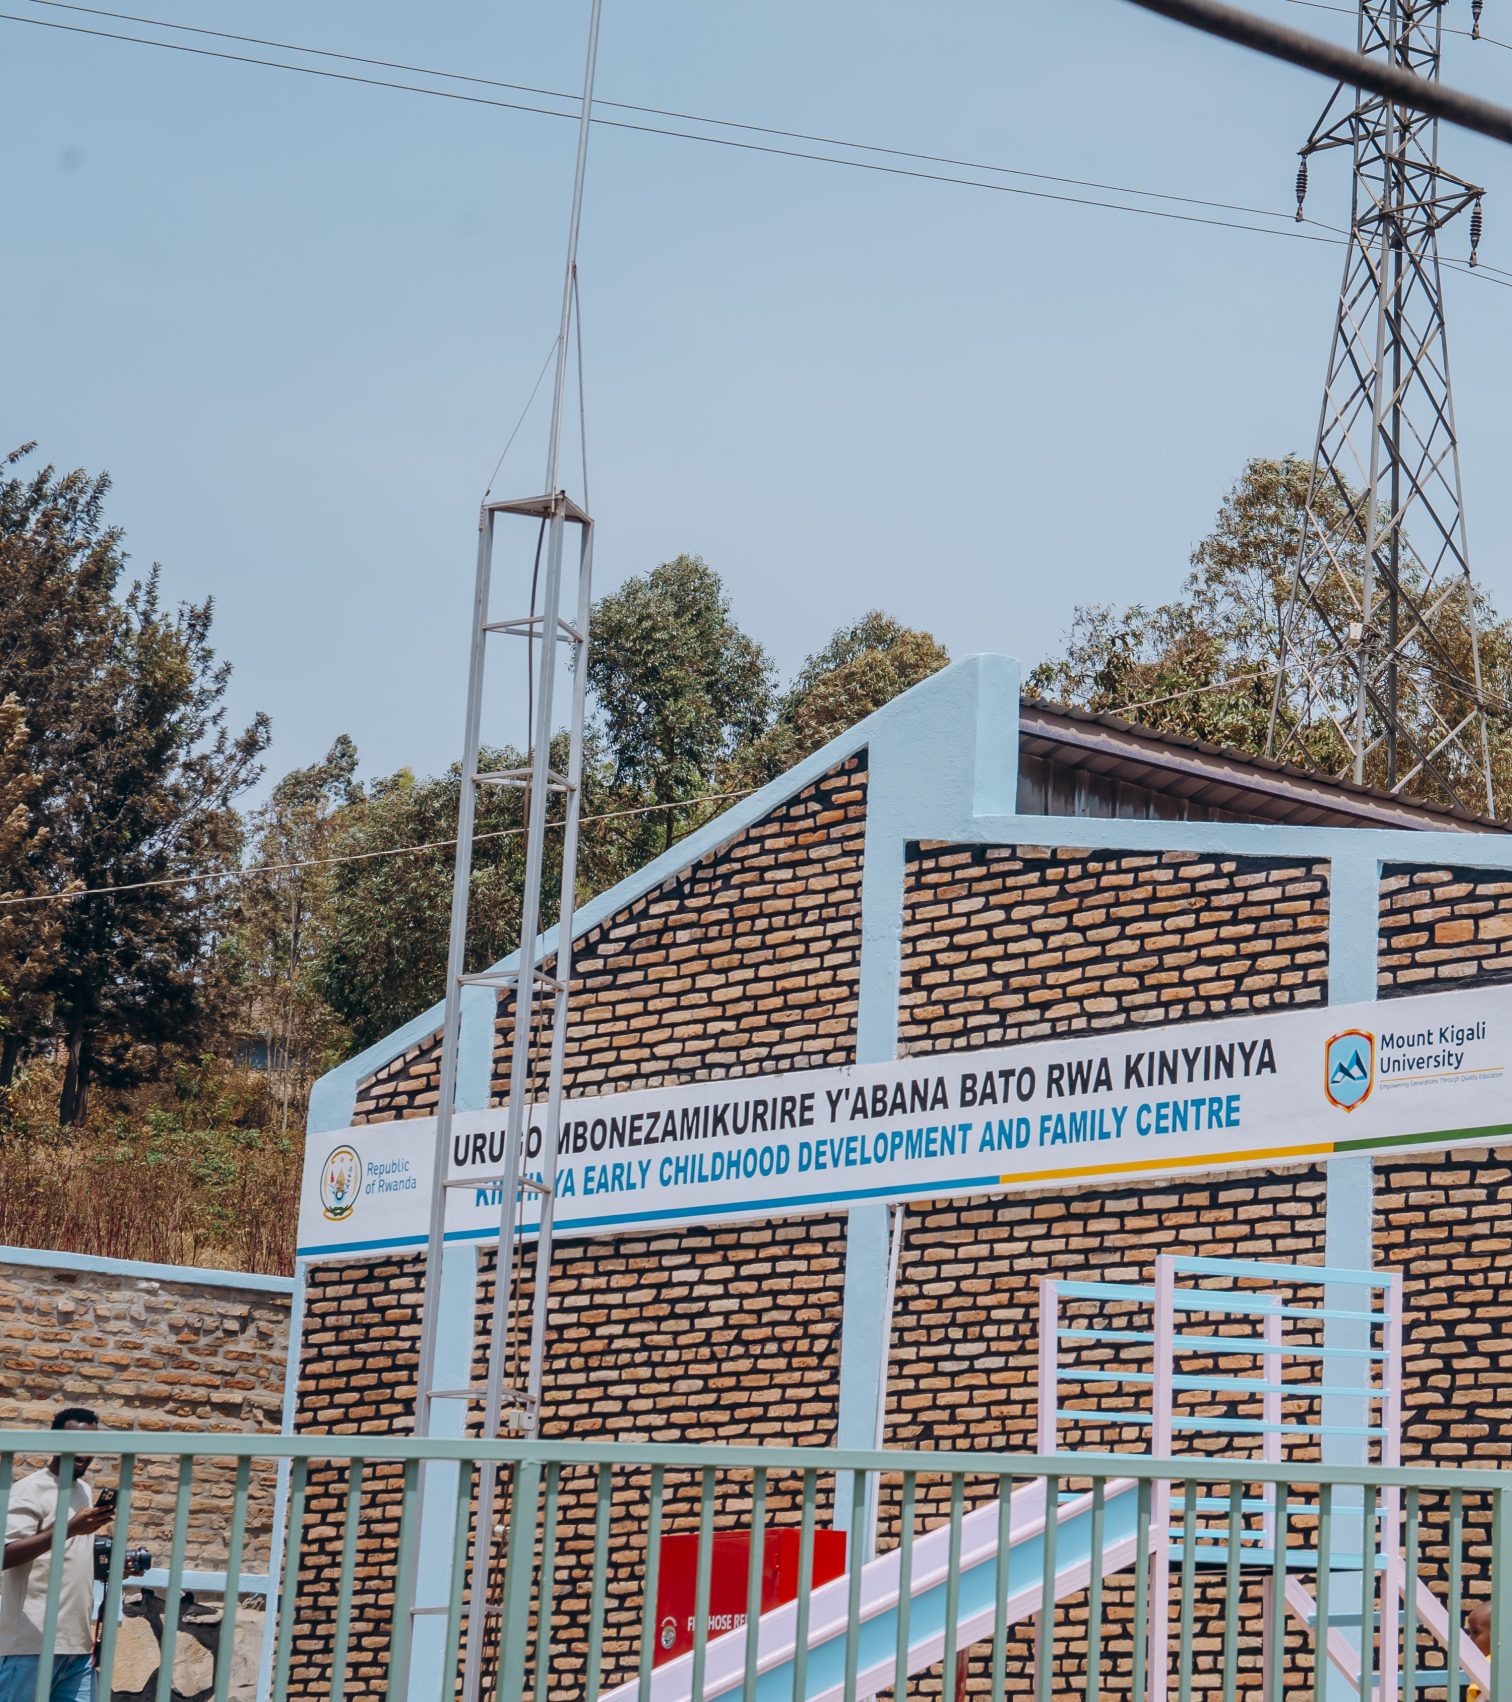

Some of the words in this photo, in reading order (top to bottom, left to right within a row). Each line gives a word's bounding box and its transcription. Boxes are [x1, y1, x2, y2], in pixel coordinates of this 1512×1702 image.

[1380, 1030, 1434, 1050] Mount
[1439, 1021, 1486, 1046] Kigali
[1380, 1049, 1464, 1074] University
[453, 1125, 542, 1167] URUO
[557, 1092, 815, 1155] MBONEZAMIKURIRE
[826, 1076, 948, 1123] Y'ABANA
[960, 1066, 1036, 1108] BATO
[1046, 1056, 1113, 1098] RWA
[1124, 1038, 1277, 1089] KINYINYA
[582, 1158, 652, 1196] EARLY
[659, 1144, 791, 1187] CHILDHOOD
[798, 1122, 972, 1173] DEVELOPMENT
[979, 1116, 1031, 1153] AND
[1039, 1106, 1128, 1145] FAMILY
[1136, 1094, 1241, 1136] CENTRE
[367, 1159, 410, 1177] Republic
[365, 1179, 376, 1195] of
[378, 1176, 417, 1192] Rwanda
[708, 1614, 732, 1631] HOSE
